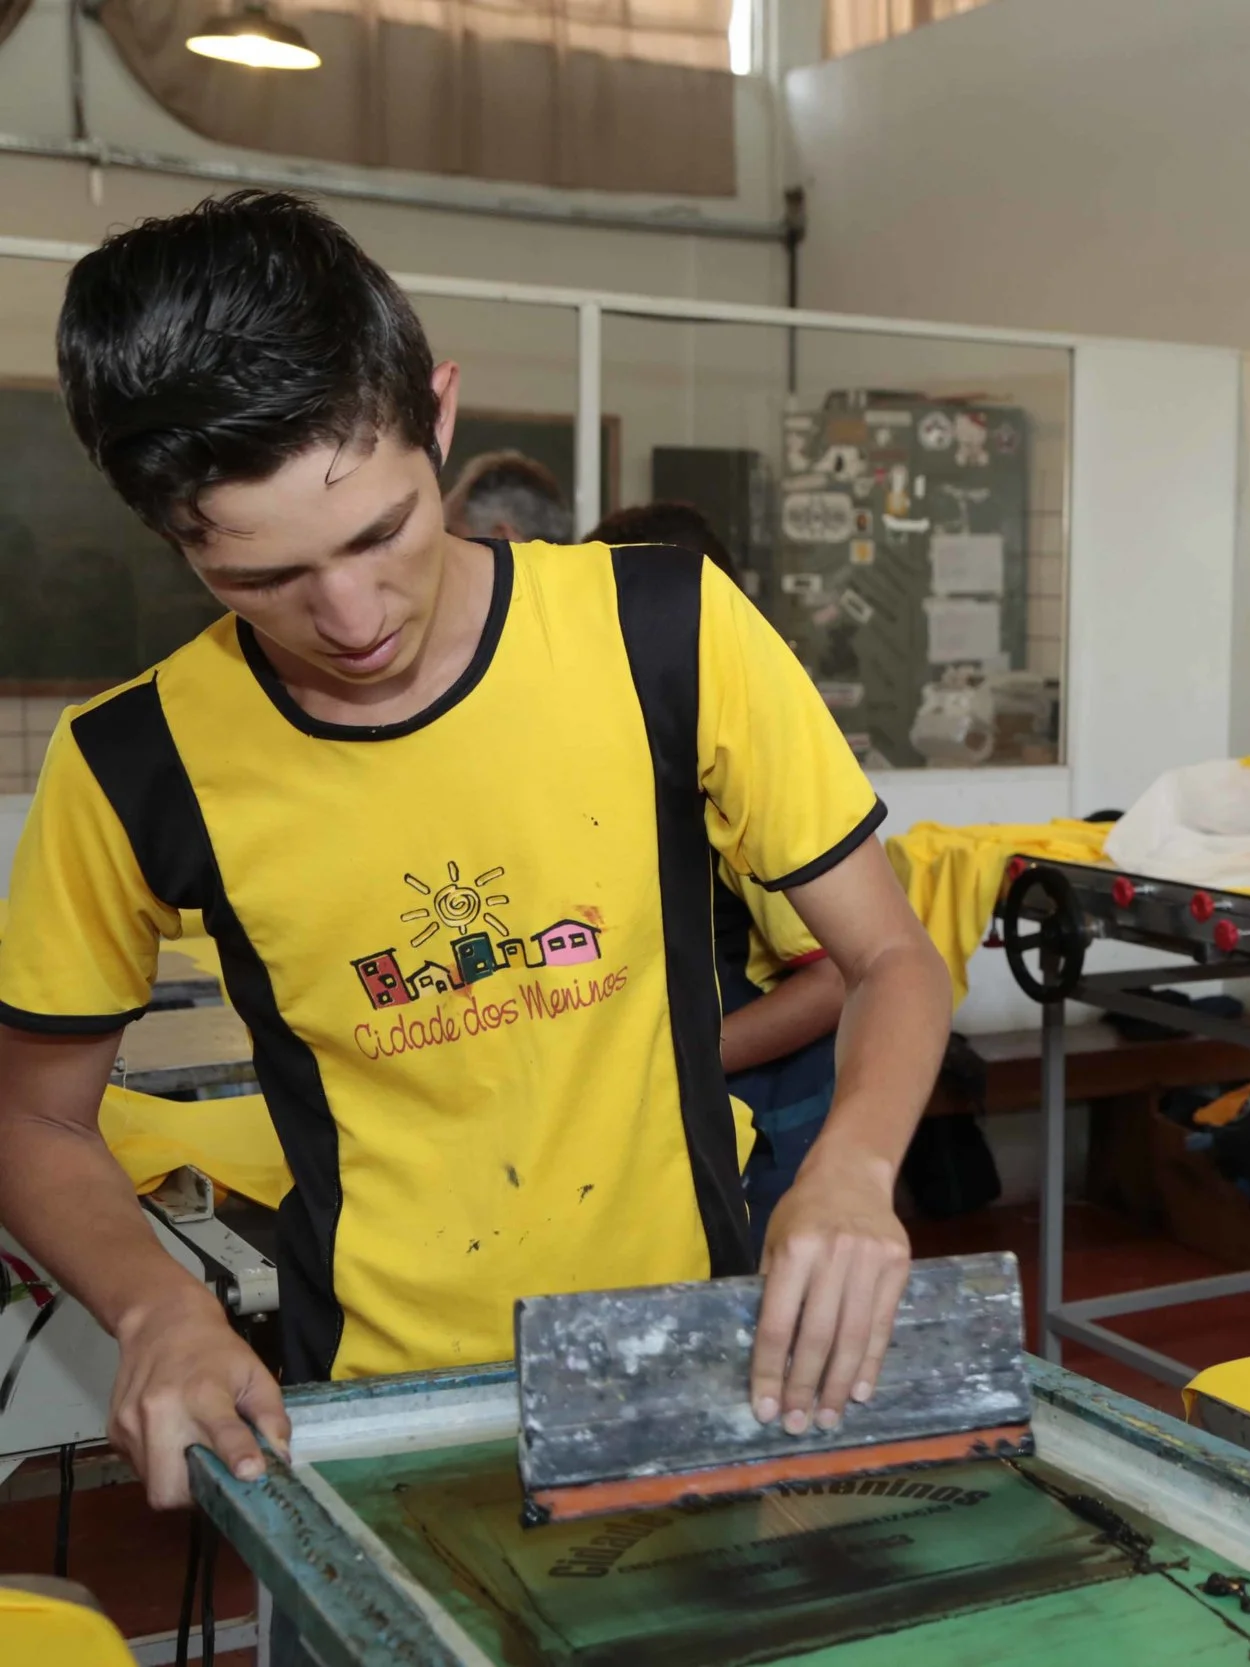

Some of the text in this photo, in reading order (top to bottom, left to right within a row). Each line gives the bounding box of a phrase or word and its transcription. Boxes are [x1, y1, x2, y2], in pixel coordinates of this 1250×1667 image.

[354, 966, 629, 1060] Cidade dos Meninos
